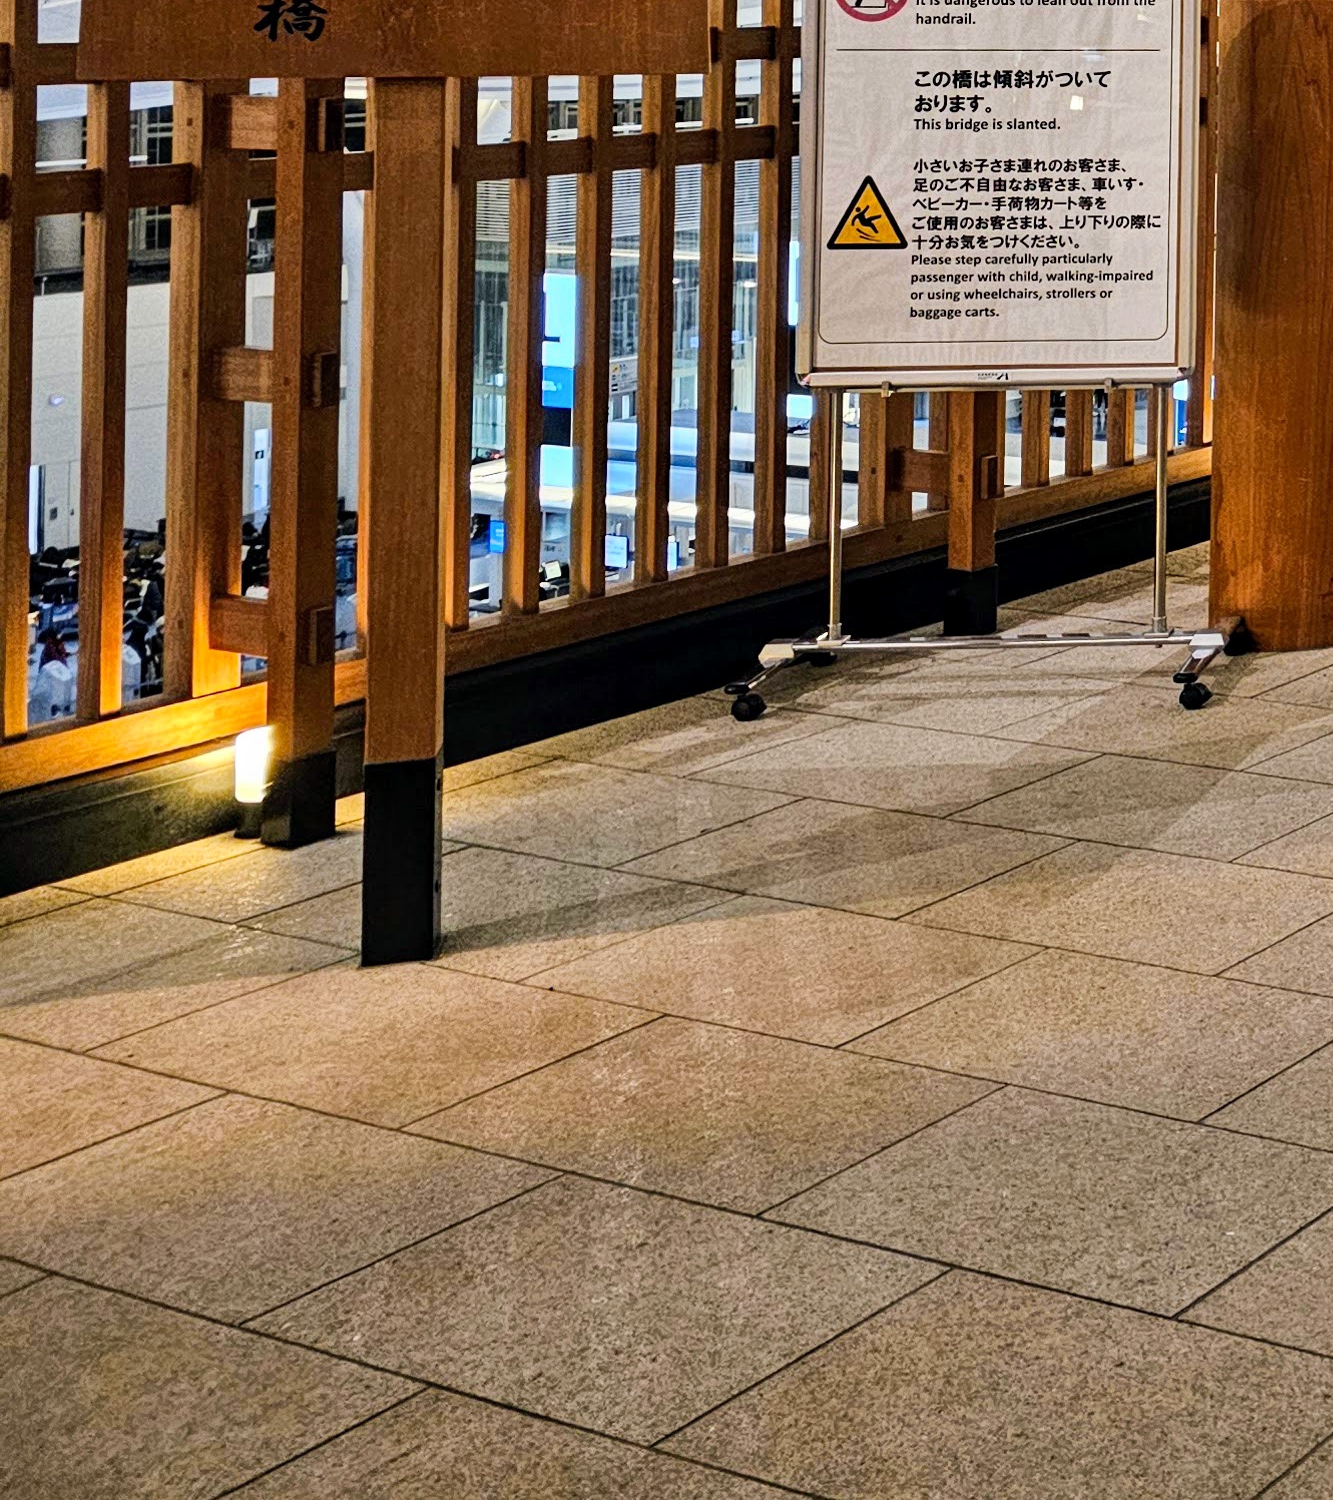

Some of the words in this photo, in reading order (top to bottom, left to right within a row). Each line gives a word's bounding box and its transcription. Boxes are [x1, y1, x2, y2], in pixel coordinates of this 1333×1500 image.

[915, 12, 976, 25] handrail.
[914, 69, 1112, 89] この橋は傾斜がついて
[914, 94, 992, 114] おります。
[913, 118, 942, 130] This
[945, 117, 989, 133] bridge
[992, 117, 1003, 130] is
[1006, 117, 1061, 130] slanted.
[911, 253, 952, 266] Please
[955, 255, 982, 268] step
[984, 252, 1039, 267] carefully
[1041, 252, 1113, 267] particularly
[910, 273, 975, 285] passenger
[977, 270, 1006, 283] with
[1009, 270, 1043, 284] child,
[1045, 269, 1154, 284] walking-impaired
[910, 291, 925, 301] or
[927, 288, 961, 303] using
[963, 287, 1043, 301] wheelchairs,
[1045, 287, 1097, 300] strollers
[1099, 290, 1113, 299] or
[909, 306, 962, 320] baggage
[964, 307, 1000, 318] carts.
